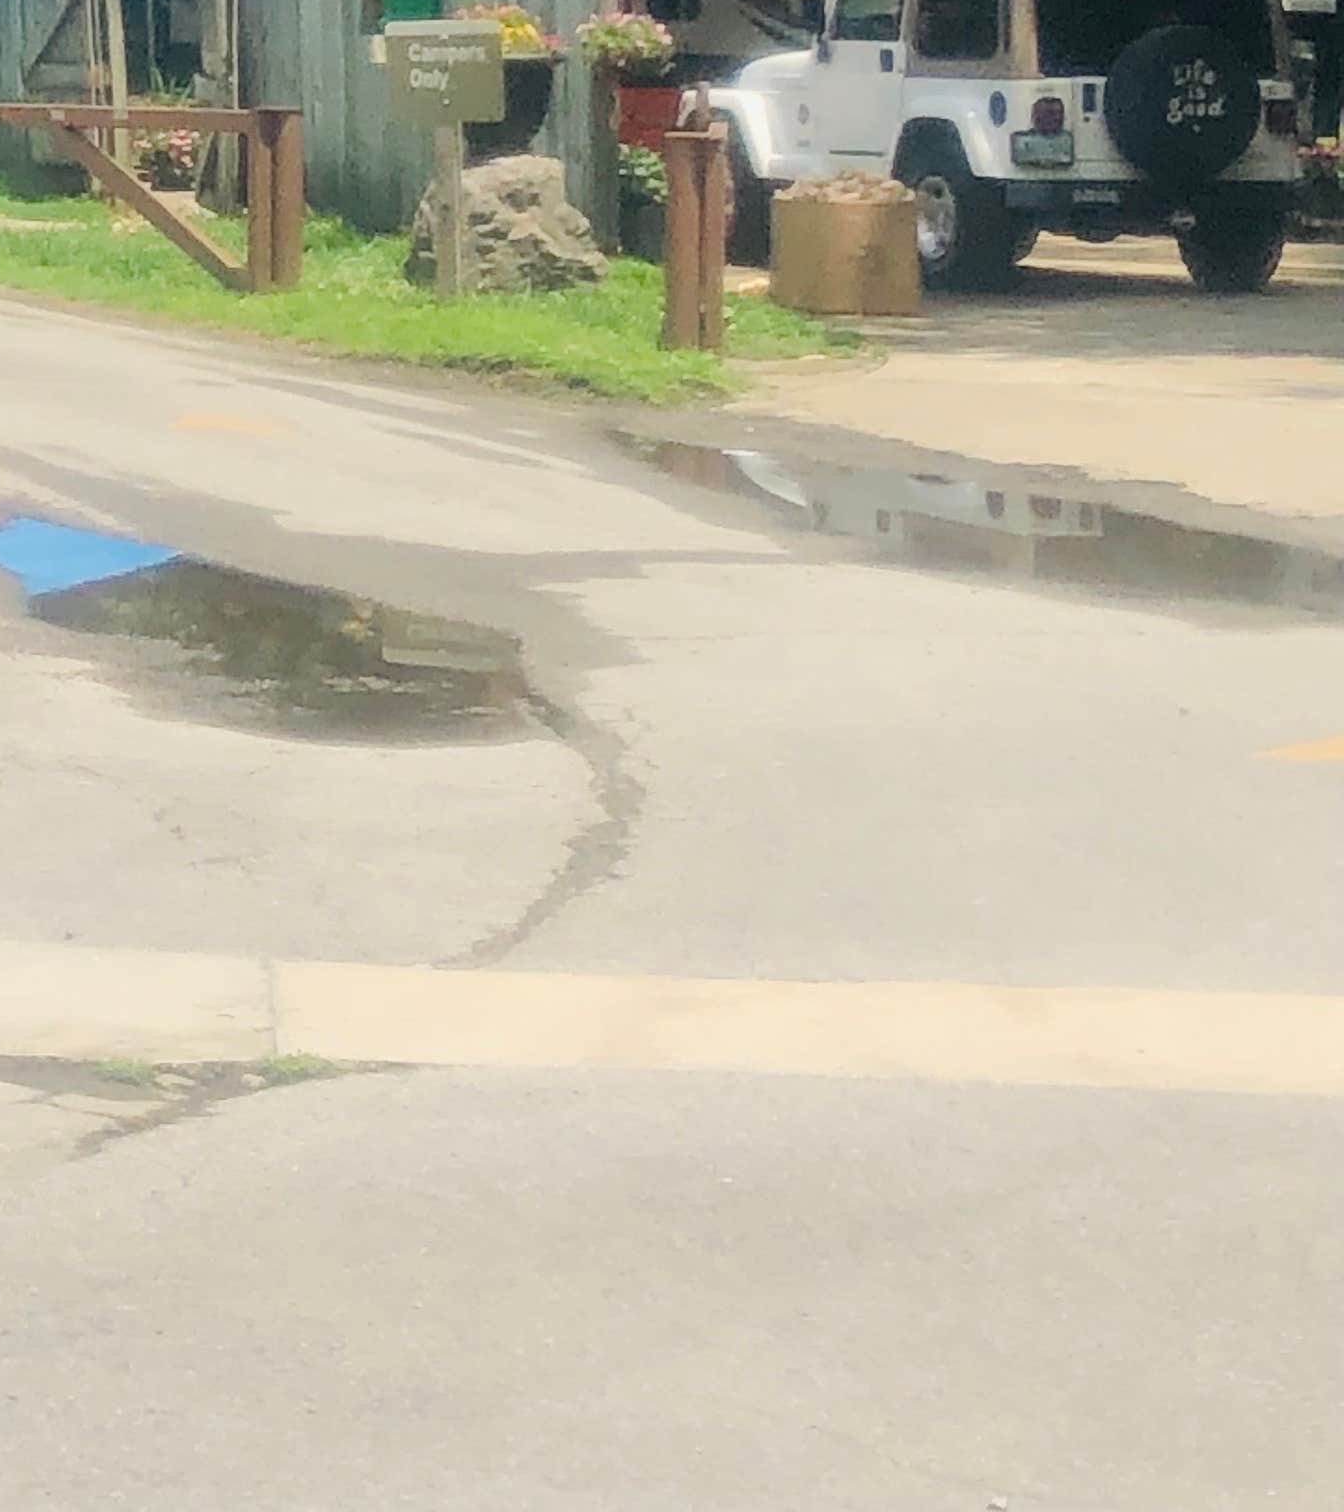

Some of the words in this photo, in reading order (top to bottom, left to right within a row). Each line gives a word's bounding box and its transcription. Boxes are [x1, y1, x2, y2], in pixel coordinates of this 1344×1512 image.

[409, 68, 450, 91] Only
[1173, 58, 1216, 86] Life
[1188, 86, 1207, 100] is
